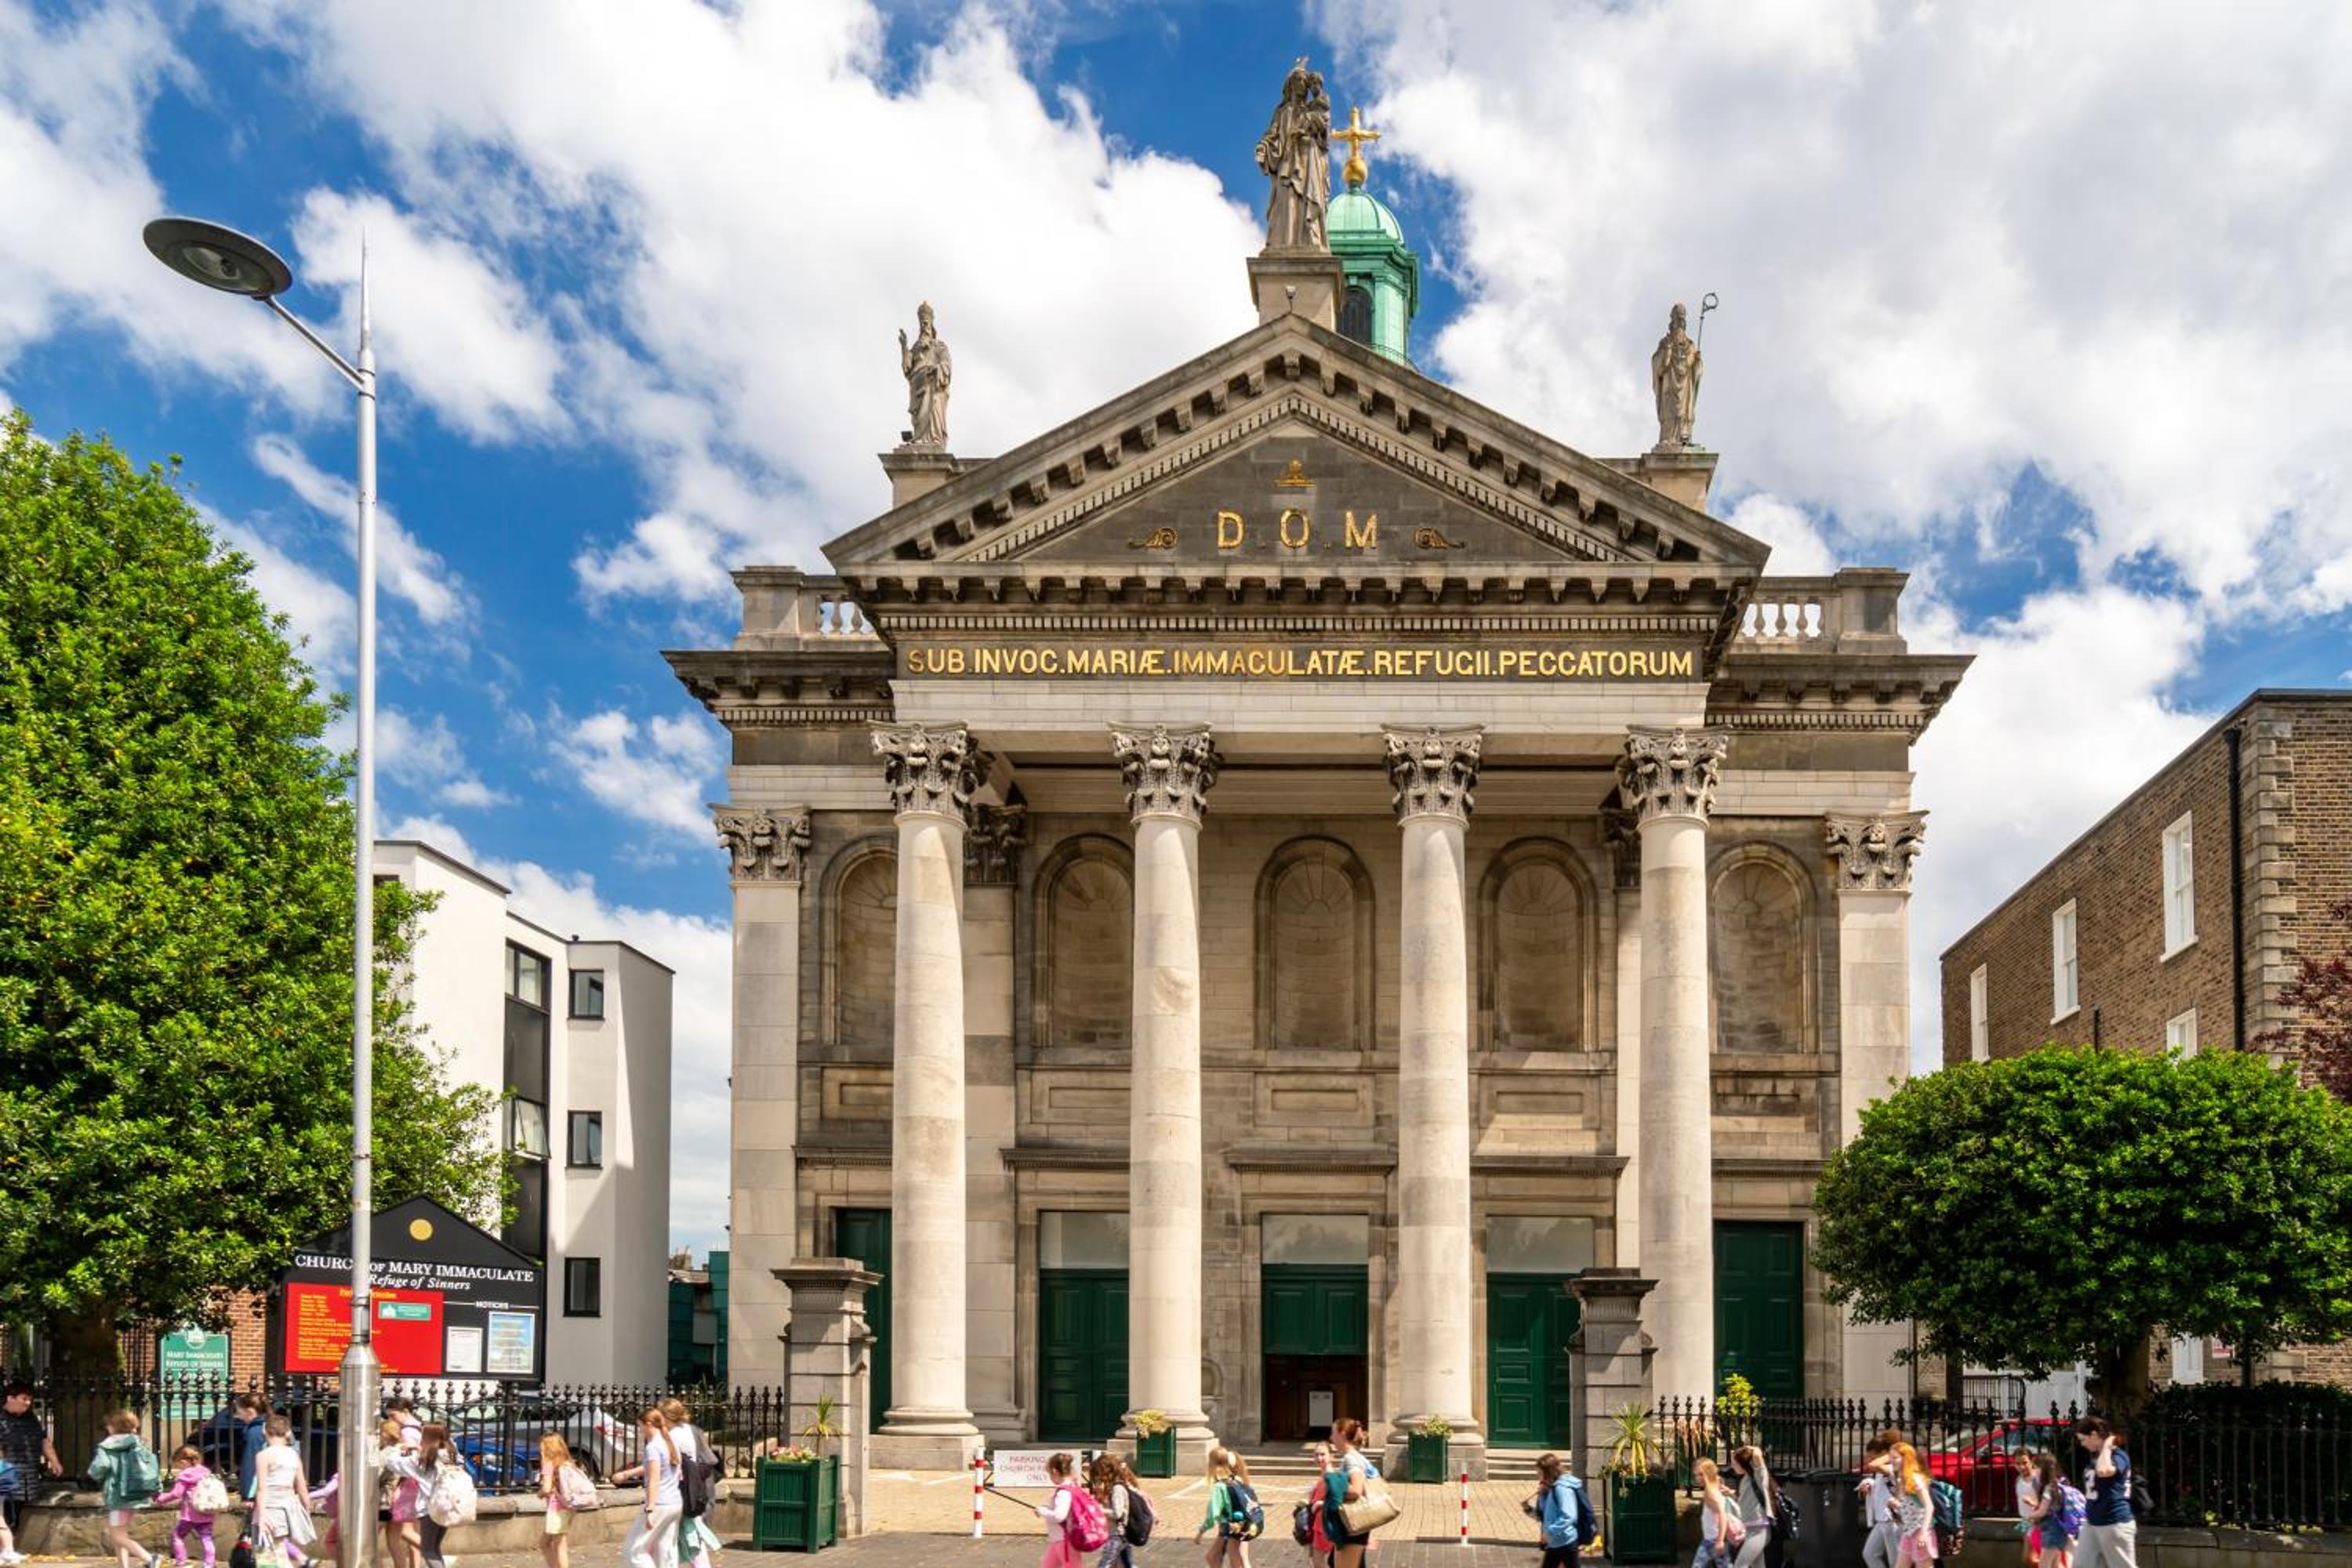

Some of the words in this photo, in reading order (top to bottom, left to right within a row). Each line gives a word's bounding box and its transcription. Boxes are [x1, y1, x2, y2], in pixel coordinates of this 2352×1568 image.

[1499, 651, 1692, 676] PECCATORUM
[295, 1254, 353, 1269] CHURC
[389, 1261, 432, 1276] MARY
[436, 1264, 534, 1282] IMMACULATE
[368, 1274, 408, 1288] Refuge
[410, 1276, 425, 1290] of
[427, 1277, 471, 1290] Sinners
